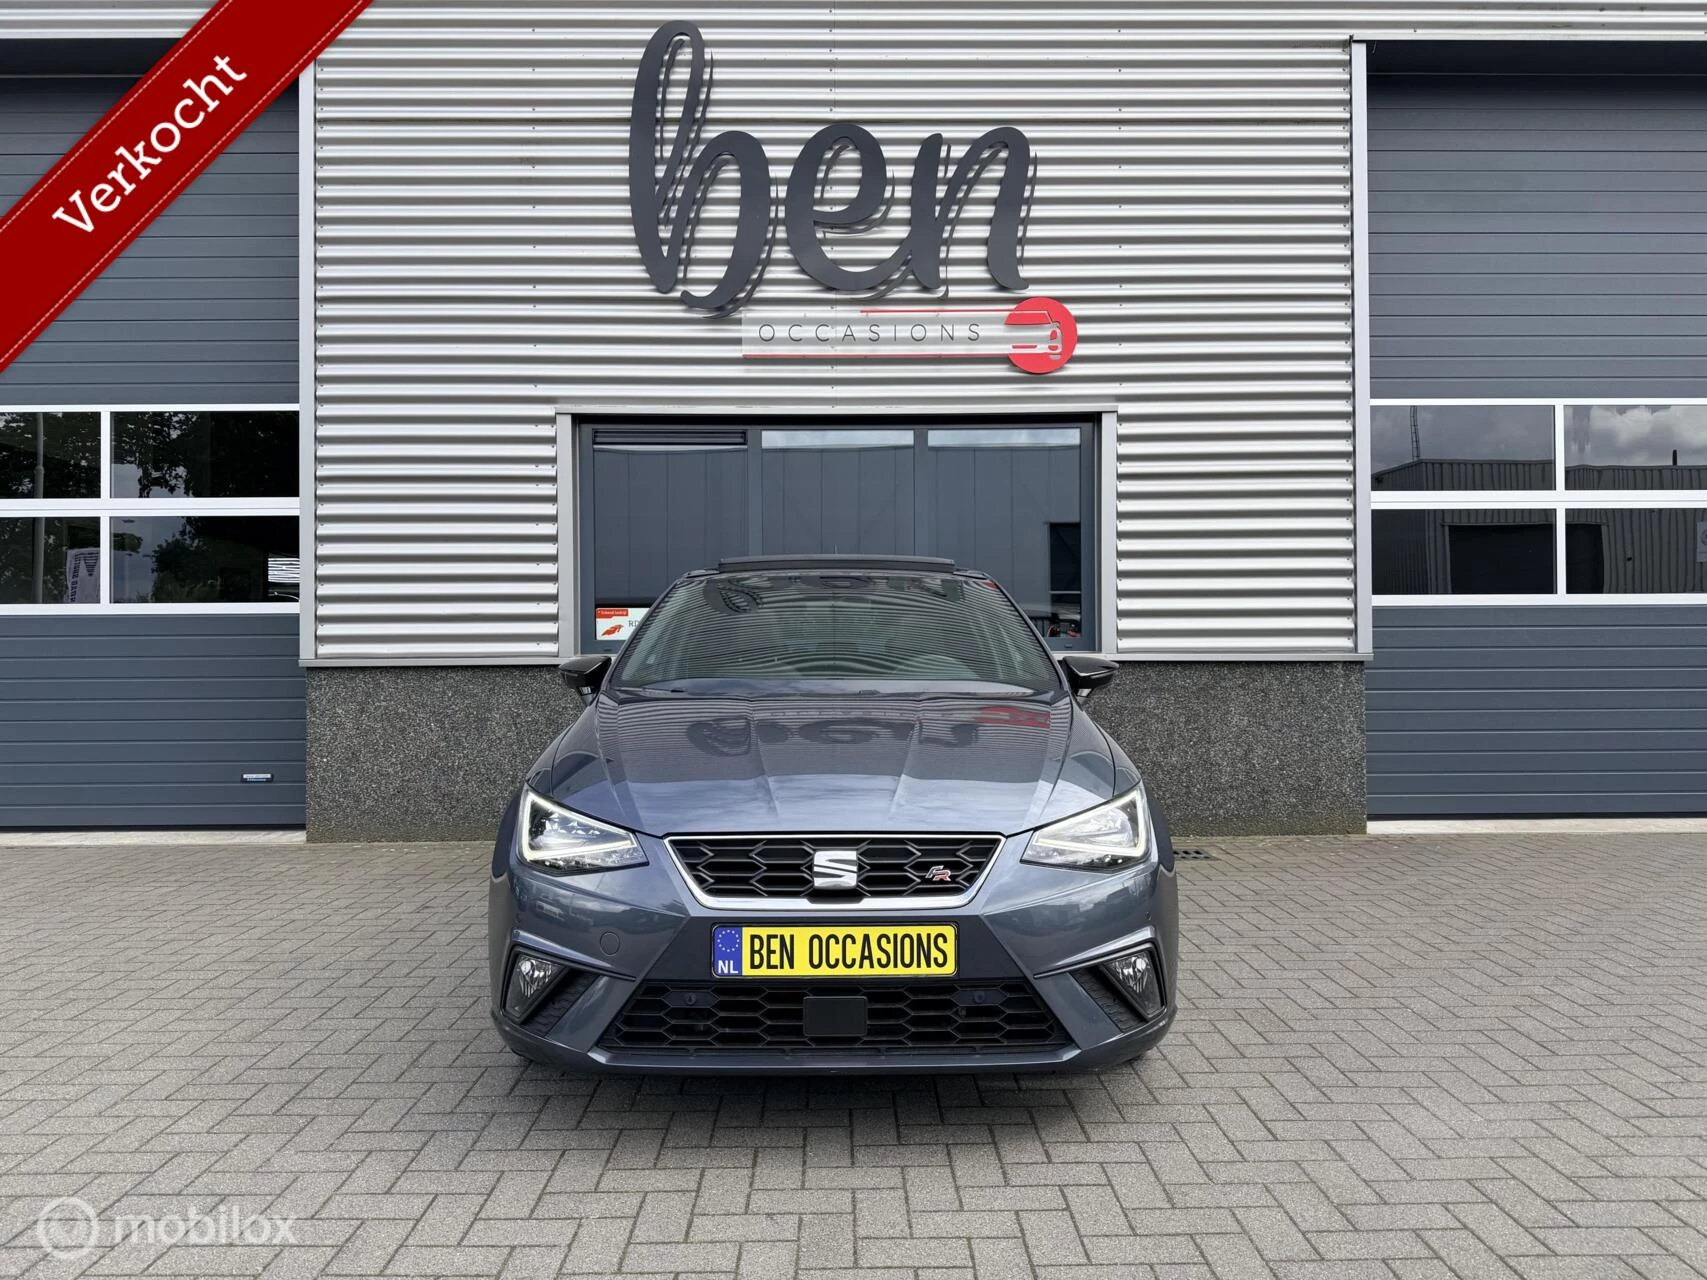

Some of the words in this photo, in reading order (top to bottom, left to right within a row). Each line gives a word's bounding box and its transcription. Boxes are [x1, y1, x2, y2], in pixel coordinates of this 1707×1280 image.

[628, 20, 1030, 309] ben
[758, 322, 981, 343] OCCASIONS
[925, 865, 951, 881] FR
[750, 934, 795, 970] BEN
[808, 932, 948, 969] OCCASIONS
[718, 960, 738, 974] NL
